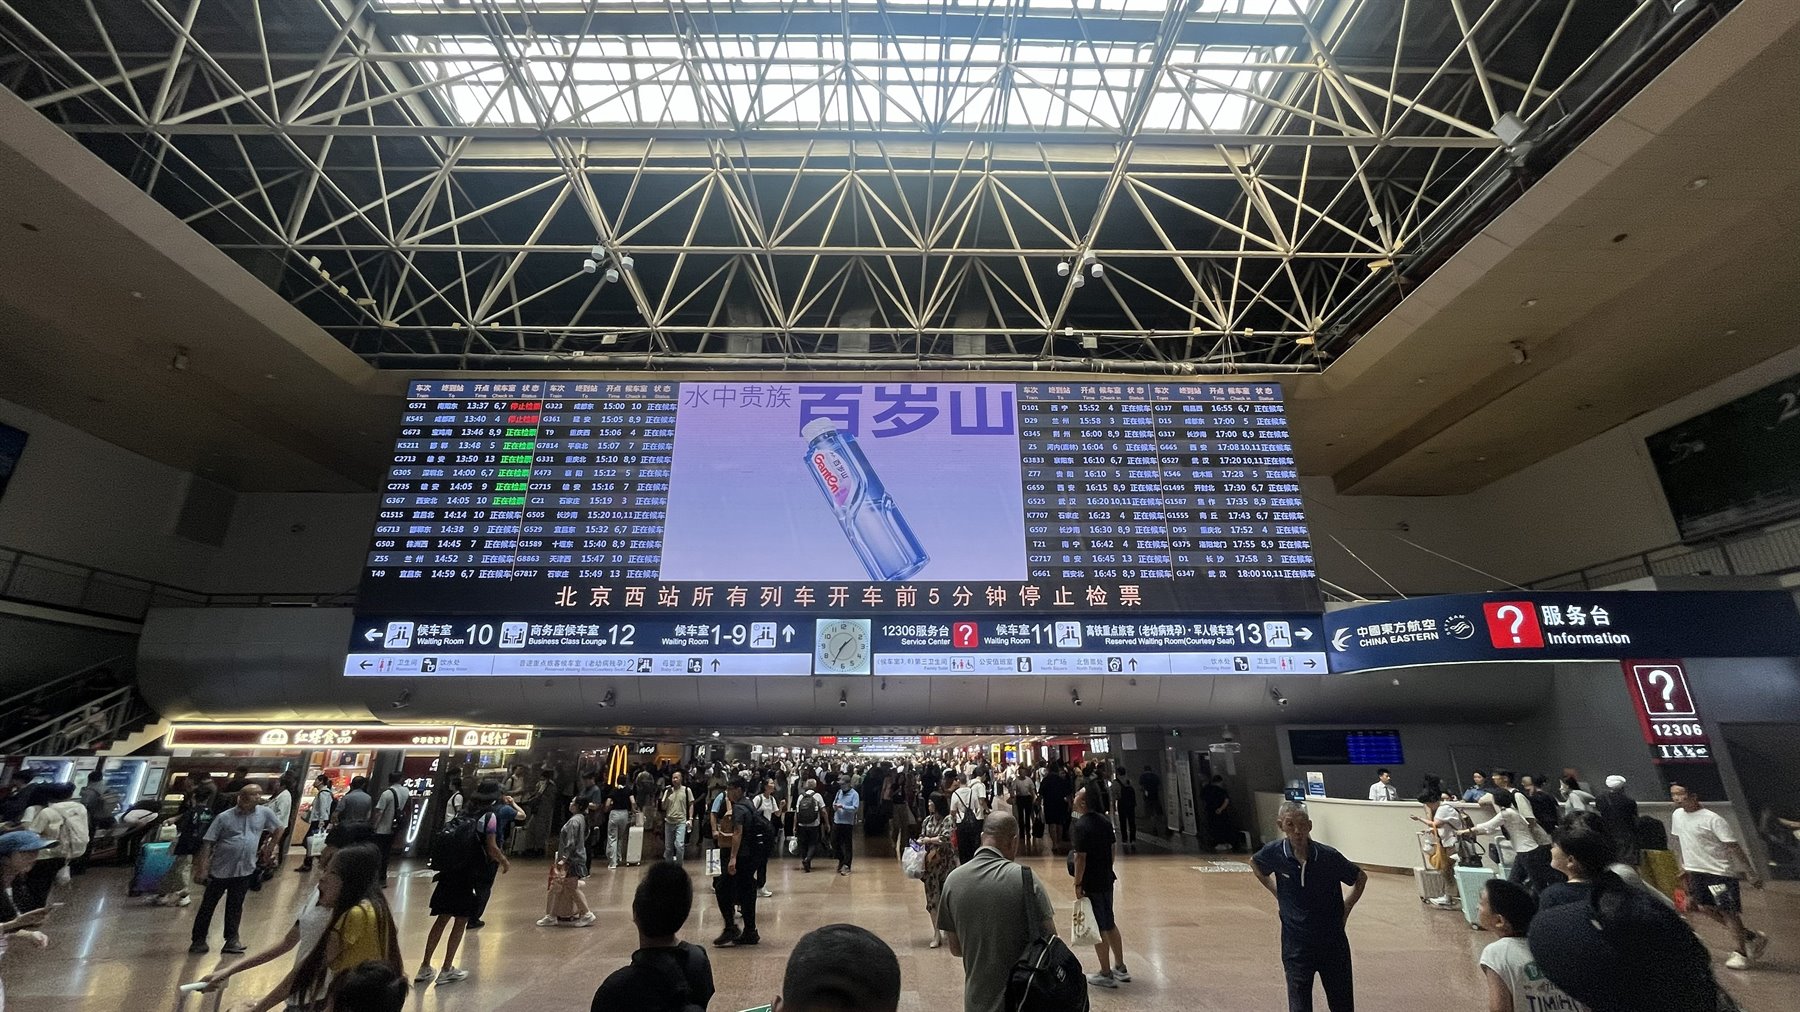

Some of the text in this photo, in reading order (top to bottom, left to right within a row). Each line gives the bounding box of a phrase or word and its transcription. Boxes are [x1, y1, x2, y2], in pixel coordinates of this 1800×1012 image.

[684, 385, 791, 409] 水中贵族
[467, 402, 489, 410] 13:37
[604, 402, 625, 410] 15:00
[1079, 404, 1099, 412] 15:52
[1212, 404, 1232, 412] 16:55
[798, 384, 1015, 438] 百岁山
[464, 415, 486, 423] 13:40
[602, 415, 623, 423] 15:05
[1080, 417, 1101, 425] 15:58
[1214, 417, 1235, 425] 17:00
[462, 428, 483, 436] 13:46
[600, 428, 621, 436] 15:06
[1081, 430, 1102, 438] 16:00
[1216, 430, 1237, 438] 17:00
[459, 441, 481, 449] 13:48
[598, 442, 620, 450] 15:07
[1083, 443, 1103, 451] 16:04
[1218, 443, 1239, 451] 17:08
[456, 455, 478, 463] 13:50
[596, 455, 618, 463] 15:10
[1084, 456, 1104, 464] 16:10
[1220, 456, 1241, 464] 17:20
[453, 469, 475, 477] 14:00
[594, 469, 616, 477] 15:12
[1085, 470, 1106, 478] 16:10
[1222, 470, 1244, 478] 17:28
[450, 482, 472, 491] 14:05
[592, 482, 614, 491] 15:16
[1086, 483, 1107, 492] 16:15
[1224, 483, 1246, 492] 17:30
[447, 496, 469, 505] 14:05
[590, 496, 612, 505] 15:19
[1088, 497, 1109, 505] 16:20
[1226, 497, 1248, 506] 17:35
[444, 511, 466, 519] 14:14
[588, 511, 610, 519] 15:20
[1089, 511, 1110, 520] 16:23
[1228, 511, 1250, 520] 17:43
[441, 525, 464, 533] 14:38
[586, 525, 608, 534] 15:32
[1090, 525, 1112, 534] 16:30
[1231, 525, 1253, 534] 17:52
[438, 539, 461, 548] 14:45
[584, 539, 606, 548] 15:40
[1091, 540, 1113, 548] 16:42
[1233, 540, 1255, 548] 17:55
[435, 554, 458, 563] 14:52
[582, 554, 604, 563] 15:47
[1093, 554, 1115, 563] 16:45
[1235, 554, 1258, 563] 17:58
[432, 569, 455, 578] 14:59
[579, 569, 602, 578] 15:49
[1094, 569, 1116, 578] 16:45
[1238, 569, 1260, 578] 18:00
[555, 586, 1142, 608] 北京西站所有列车开车前5分钟停止检票
[1541, 604, 1611, 626] 服务台
[882, 624, 949, 637] 12306服务台
[1356, 618, 1437, 638] 中國東方航空
[417, 624, 493, 646] 候车室 10
[530, 624, 636, 645] 商务座候车室 12
[674, 624, 747, 645] 候车室 1-9
[996, 623, 1053, 645] 候车室 11
[1235, 623, 1263, 644] 13
[1547, 631, 1631, 645] Information
[417, 637, 442, 646] Waiting
[528, 637, 607, 647] Business Class Lounge
[661, 637, 687, 646] Waiting
[901, 637, 951, 645] Service Center
[984, 637, 1009, 646] Waiting
[1105, 637, 1235, 646] Reserved Waiting Room(Courtesy Seat)
[1359, 632, 1439, 647] CHINA EASTERN
[626, 658, 635, 672] 2
[1652, 723, 1703, 736] 12306
